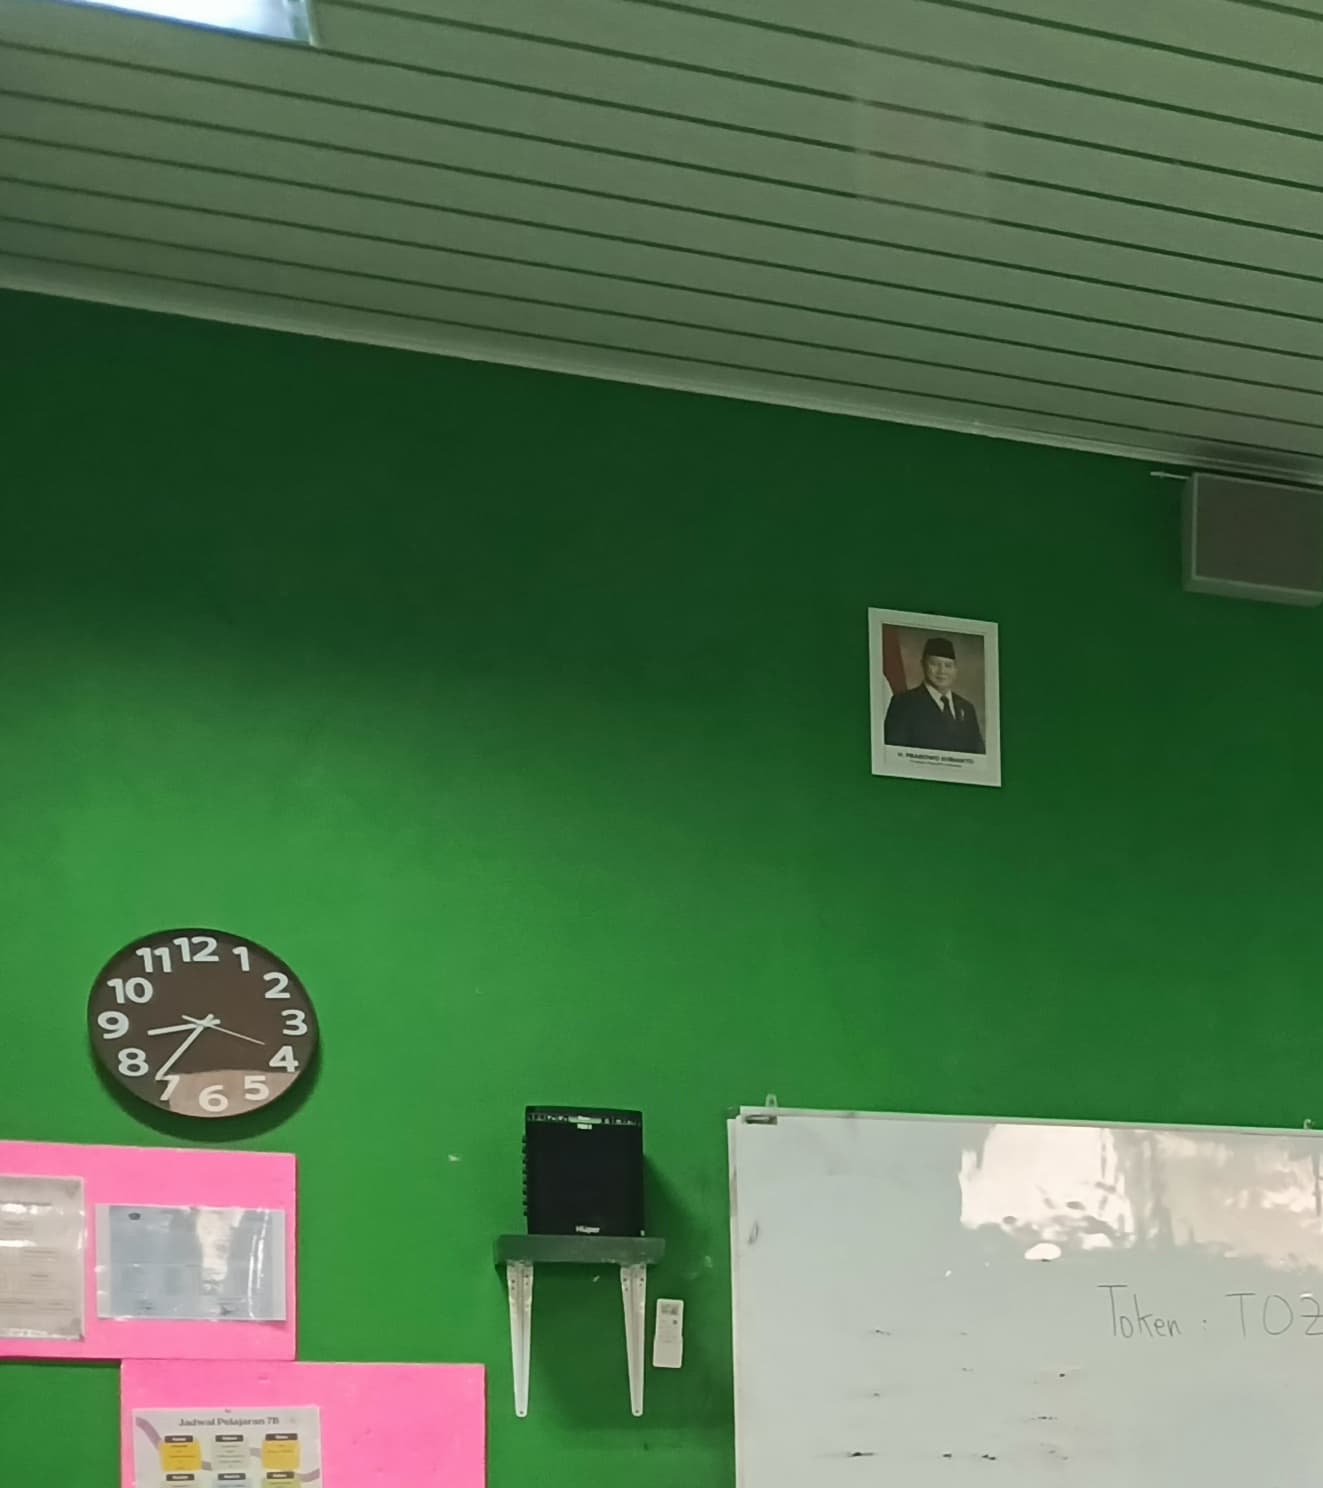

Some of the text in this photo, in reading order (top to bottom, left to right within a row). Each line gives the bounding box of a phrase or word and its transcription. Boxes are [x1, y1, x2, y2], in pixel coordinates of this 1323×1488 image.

[136, 946, 172, 973] 11
[173, 936, 220, 963] 12
[232, 946, 251, 972] 1
[106, 977, 154, 1004] 10
[263, 972, 291, 999] 2
[97, 1010, 129, 1040] 9
[281, 1009, 308, 1036] 3
[118, 1048, 149, 1077] 8
[268, 1046, 299, 1073] 4
[160, 1074, 180, 1101] 7
[198, 1085, 229, 1112] 6
[244, 1075, 270, 1101] 5
[1096, 1284, 1181, 1339] Token
